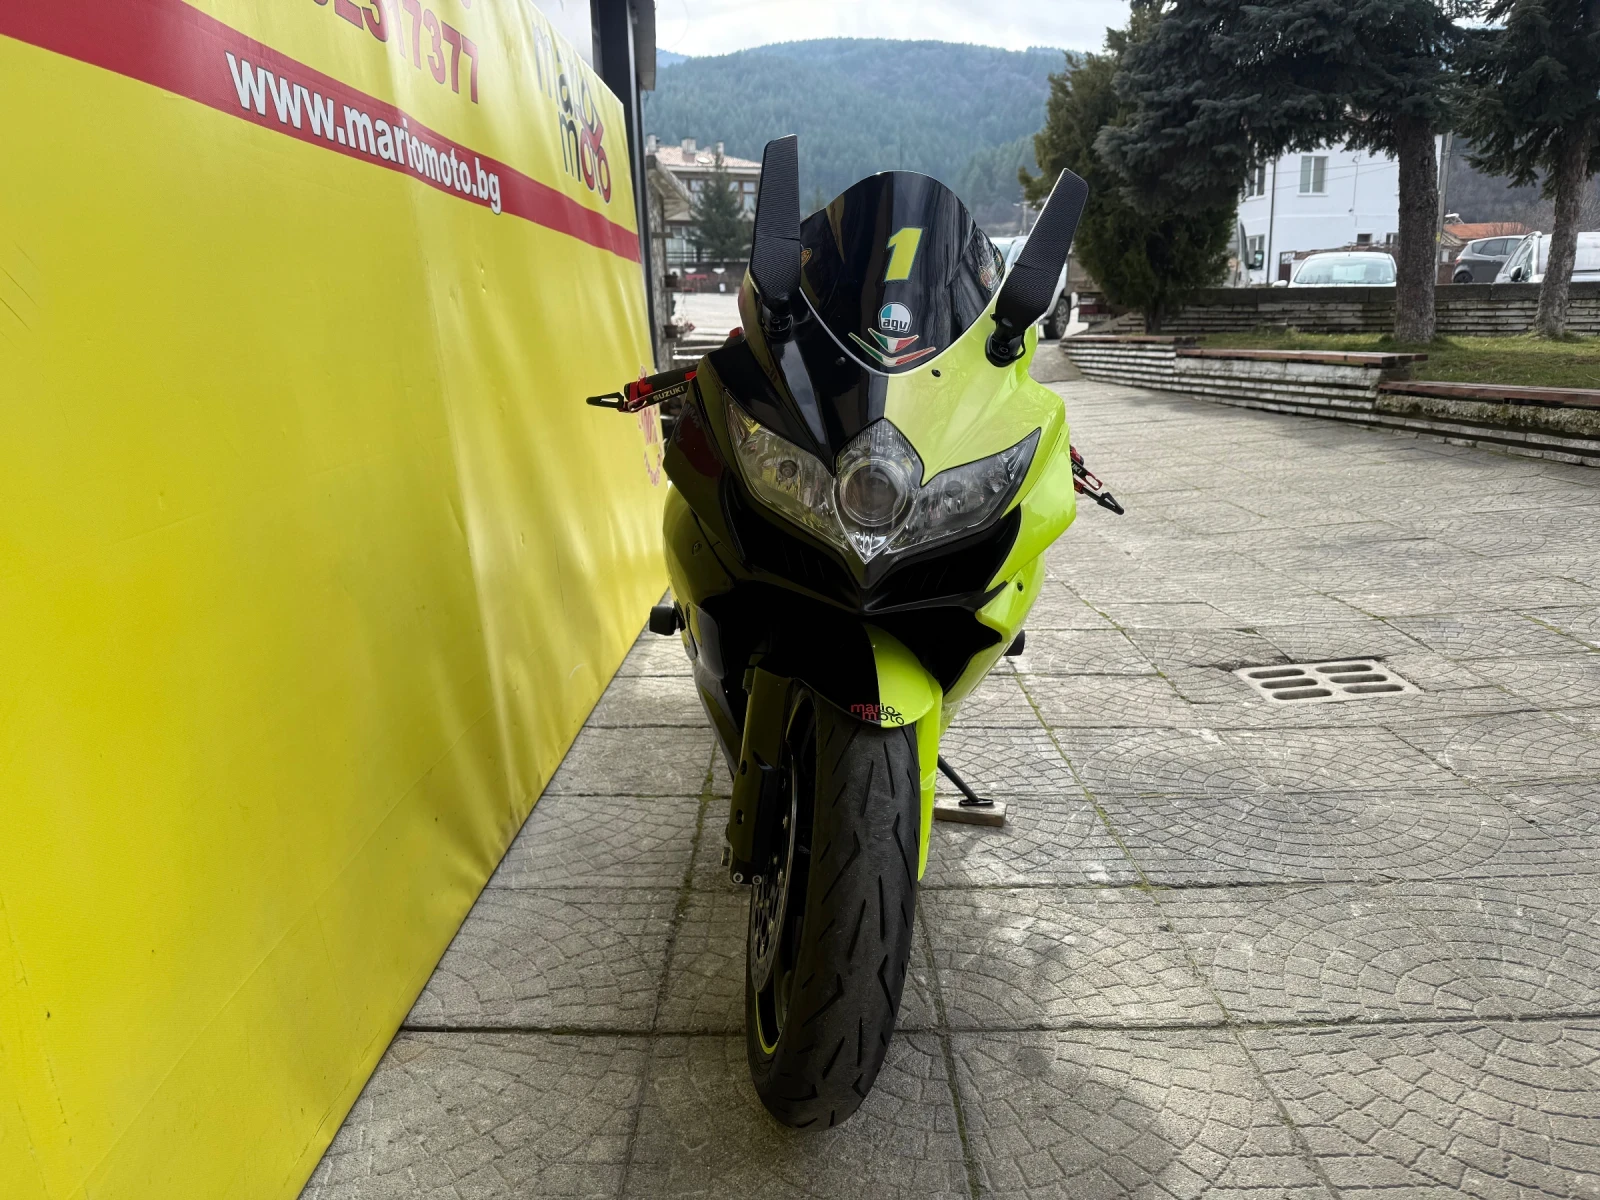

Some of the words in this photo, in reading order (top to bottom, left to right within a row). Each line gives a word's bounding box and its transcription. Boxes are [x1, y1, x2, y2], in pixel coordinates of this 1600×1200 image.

[224, 51, 502, 215] www.mariomoto.bg
[884, 227, 923, 283] 1
[882, 317, 908, 332] agv
[652, 385, 685, 401] SUZUKI
[850, 703, 896, 717] mario
[861, 710, 905, 725] moto
